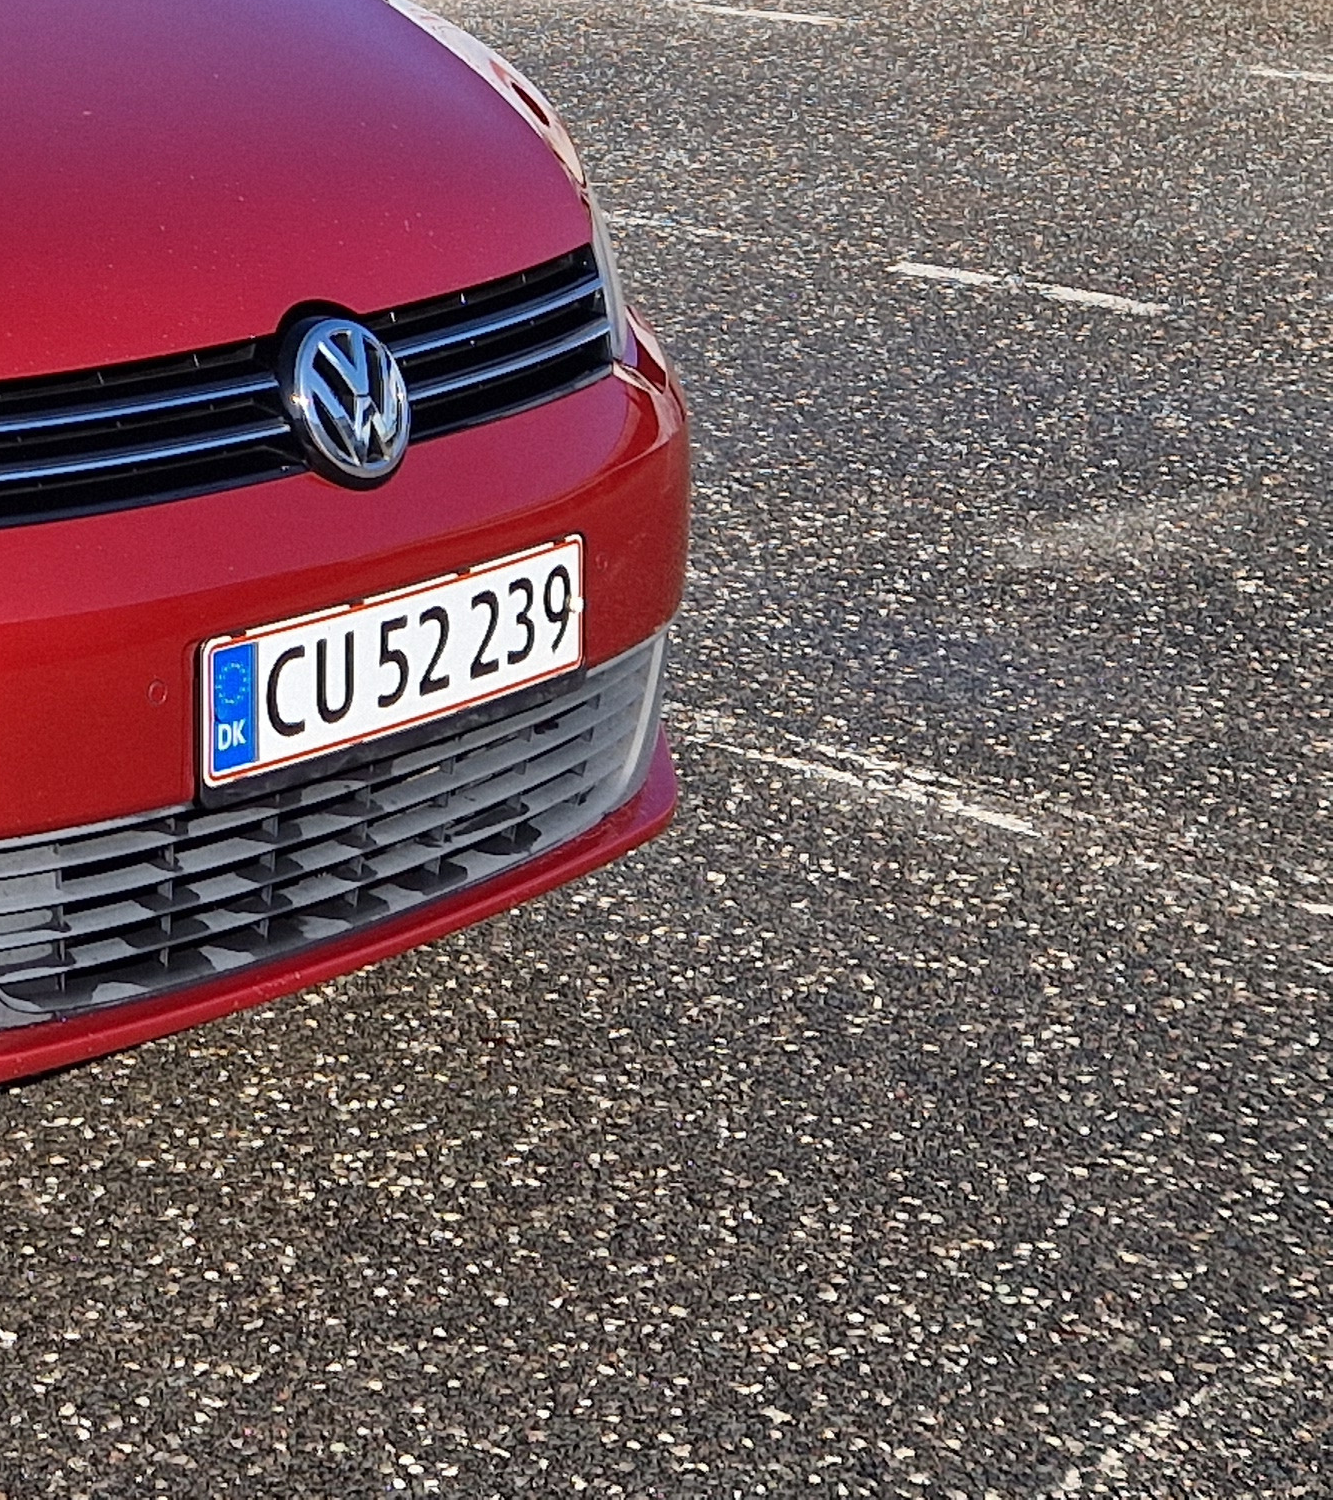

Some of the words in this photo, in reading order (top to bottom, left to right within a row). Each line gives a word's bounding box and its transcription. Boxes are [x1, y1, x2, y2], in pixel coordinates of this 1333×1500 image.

[266, 630, 355, 738] CU
[377, 605, 450, 709] 52
[470, 563, 572, 680] 239
[217, 719, 246, 751] DK
